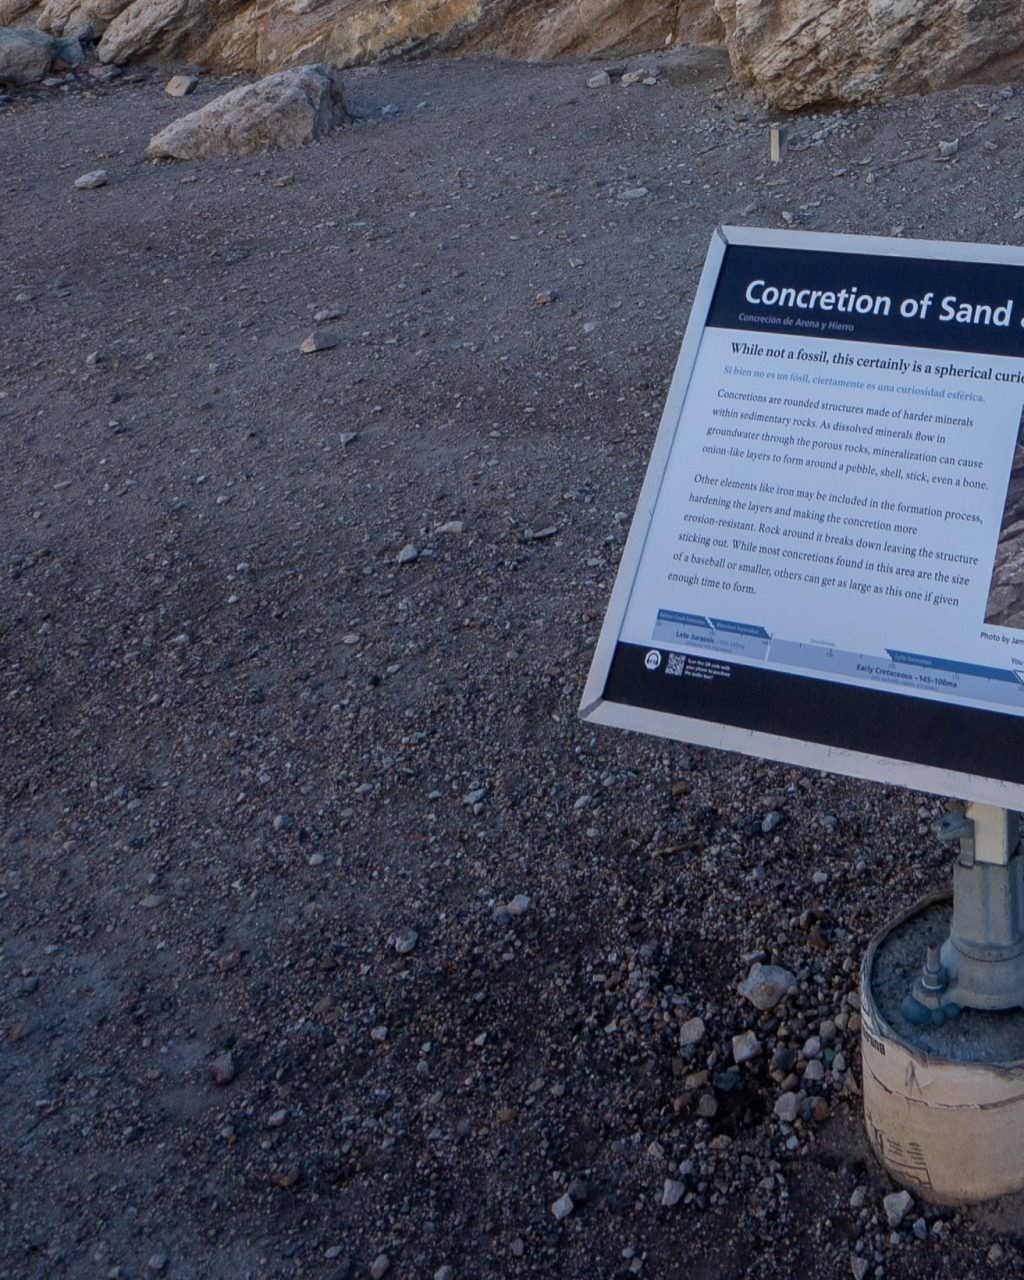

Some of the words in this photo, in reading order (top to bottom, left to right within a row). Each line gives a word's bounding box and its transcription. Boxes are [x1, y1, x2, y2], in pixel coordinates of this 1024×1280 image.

[738, 312, 782, 325] Concreción
[782, 315, 794, 326] de
[794, 317, 820, 329] Arena
[820, 321, 828, 331] y
[827, 320, 855, 332] Hierro
[745, 279, 892, 316] Concretion
[899, 292, 935, 320] of
[938, 295, 1014, 327] Sand
[731, 341, 764, 357] While
[765, 348, 786, 359] not
[786, 350, 795, 360] a
[796, 347, 830, 365] fossil,
[832, 352, 855, 366] this
[856, 357, 911, 375] certainly
[911, 360, 923, 373] is
[923, 364, 932, 374] a
[934, 363, 993, 381] spherical
[723, 364, 733, 375] Si
[733, 365, 753, 377] bien
[752, 370, 766, 379] no
[765, 371, 776, 380] es
[776, 372, 789, 382] un
[789, 371, 811, 385] fósil,
[811, 375, 866, 390] ciertamente
[865, 382, 876, 391] es
[876, 383, 895, 393] una
[895, 385, 946, 399] curiosidad
[946, 390, 986, 403] esférica.
[712, 407, 739, 419] within
[739, 410, 792, 428] sedimentary
[792, 417, 818, 429] rocks.
[819, 419, 831, 430] As
[832, 420, 874, 436] dissolved
[874, 427, 914, 441] minerals
[914, 430, 936, 443] flow
[936, 433, 946, 445] in
[716, 388, 767, 403] Concretions
[767, 396, 783, 405] are
[782, 397, 821, 410] rounded
[820, 401, 865, 415] structures
[865, 407, 891, 418] made
[891, 408, 903, 419] of
[902, 409, 934, 423] harder
[934, 414, 974, 428] minerals
[705, 426, 761, 441] groundwater
[760, 431, 795, 447] through
[796, 435, 811, 448] the
[810, 440, 843, 451] porous
[844, 443, 871, 457] rocks,
[872, 446, 938, 463] mineralization
[938, 456, 956, 466] can
[956, 458, 984, 469] cause
[701, 445, 746, 459] onion-like
[745, 448, 771, 463] layers
[771, 453, 782, 463] to
[782, 453, 804, 466] form
[804, 458, 838, 471] around
[838, 463, 845, 472] a
[844, 463, 879, 478] pebble,
[879, 466, 904, 481] shell,
[905, 470, 930, 485] stick,
[931, 475, 954, 486] even
[954, 478, 961, 487] a
[962, 476, 989, 491] bone.
[688, 491, 732, 511] hardening
[732, 498, 747, 510] the
[747, 500, 774, 515] layers
[774, 506, 792, 517] and
[792, 508, 826, 525] making
[826, 512, 842, 524] the
[842, 516, 892, 532] concretion
[893, 524, 918, 536] more
[693, 472, 720, 487] Other
[719, 477, 758, 492] elements
[758, 481, 776, 494] like
[775, 484, 795, 497] iron
[795, 489, 815, 502] may
[815, 489, 828, 502] be
[828, 492, 869, 508] included
[869, 497, 879, 509] in
[880, 499, 896, 512] the
[896, 501, 943, 518] formation
[943, 510, 984, 525] process,
[677, 531, 712, 548] sticking
[711, 538, 729, 549] out.
[732, 538, 758, 553] While
[757, 545, 781, 557] most
[781, 549, 835, 566] concretions
[835, 555, 864, 570] found
[864, 559, 875, 572] in
[876, 561, 894, 575] this
[894, 567, 916, 578] area
[916, 570, 933, 581] are
[933, 570, 950, 583] the
[951, 573, 971, 586] size
[683, 513, 757, 532] erosion-resistant.
[757, 522, 782, 536] Rock
[781, 528, 816, 541] around
[815, 531, 824, 543] it
[824, 532, 855, 547] breaks
[855, 536, 882, 552] down
[883, 540, 917, 559] leaving
[918, 546, 934, 559] the
[934, 551, 979, 566] structure
[667, 572, 700, 587] enough
[700, 576, 721, 590] time
[721, 580, 732, 591] to
[732, 580, 757, 595] form.
[672, 551, 685, 562] of
[683, 554, 690, 563] a
[690, 553, 726, 569] baseball
[726, 561, 738, 571] or
[737, 563, 772, 578] smaller,
[773, 567, 803, 582] others
[803, 574, 821, 585] can
[820, 576, 836, 588] get
[836, 579, 848, 589] as
[848, 578, 872, 595] large
[872, 585, 884, 595] as
[884, 584, 904, 598] this
[904, 590, 923, 601] one
[923, 591, 934, 602] if
[932, 593, 960, 607] given
[675, 630, 689, 639] Late
[689, 632, 715, 644] Jurassic
[979, 631, 1001, 642] Photo
[1001, 634, 1011, 646] by
[855, 663, 873, 674] Early
[874, 666, 913, 680] Cretaceous
[1010, 656, 1024, 666] You
